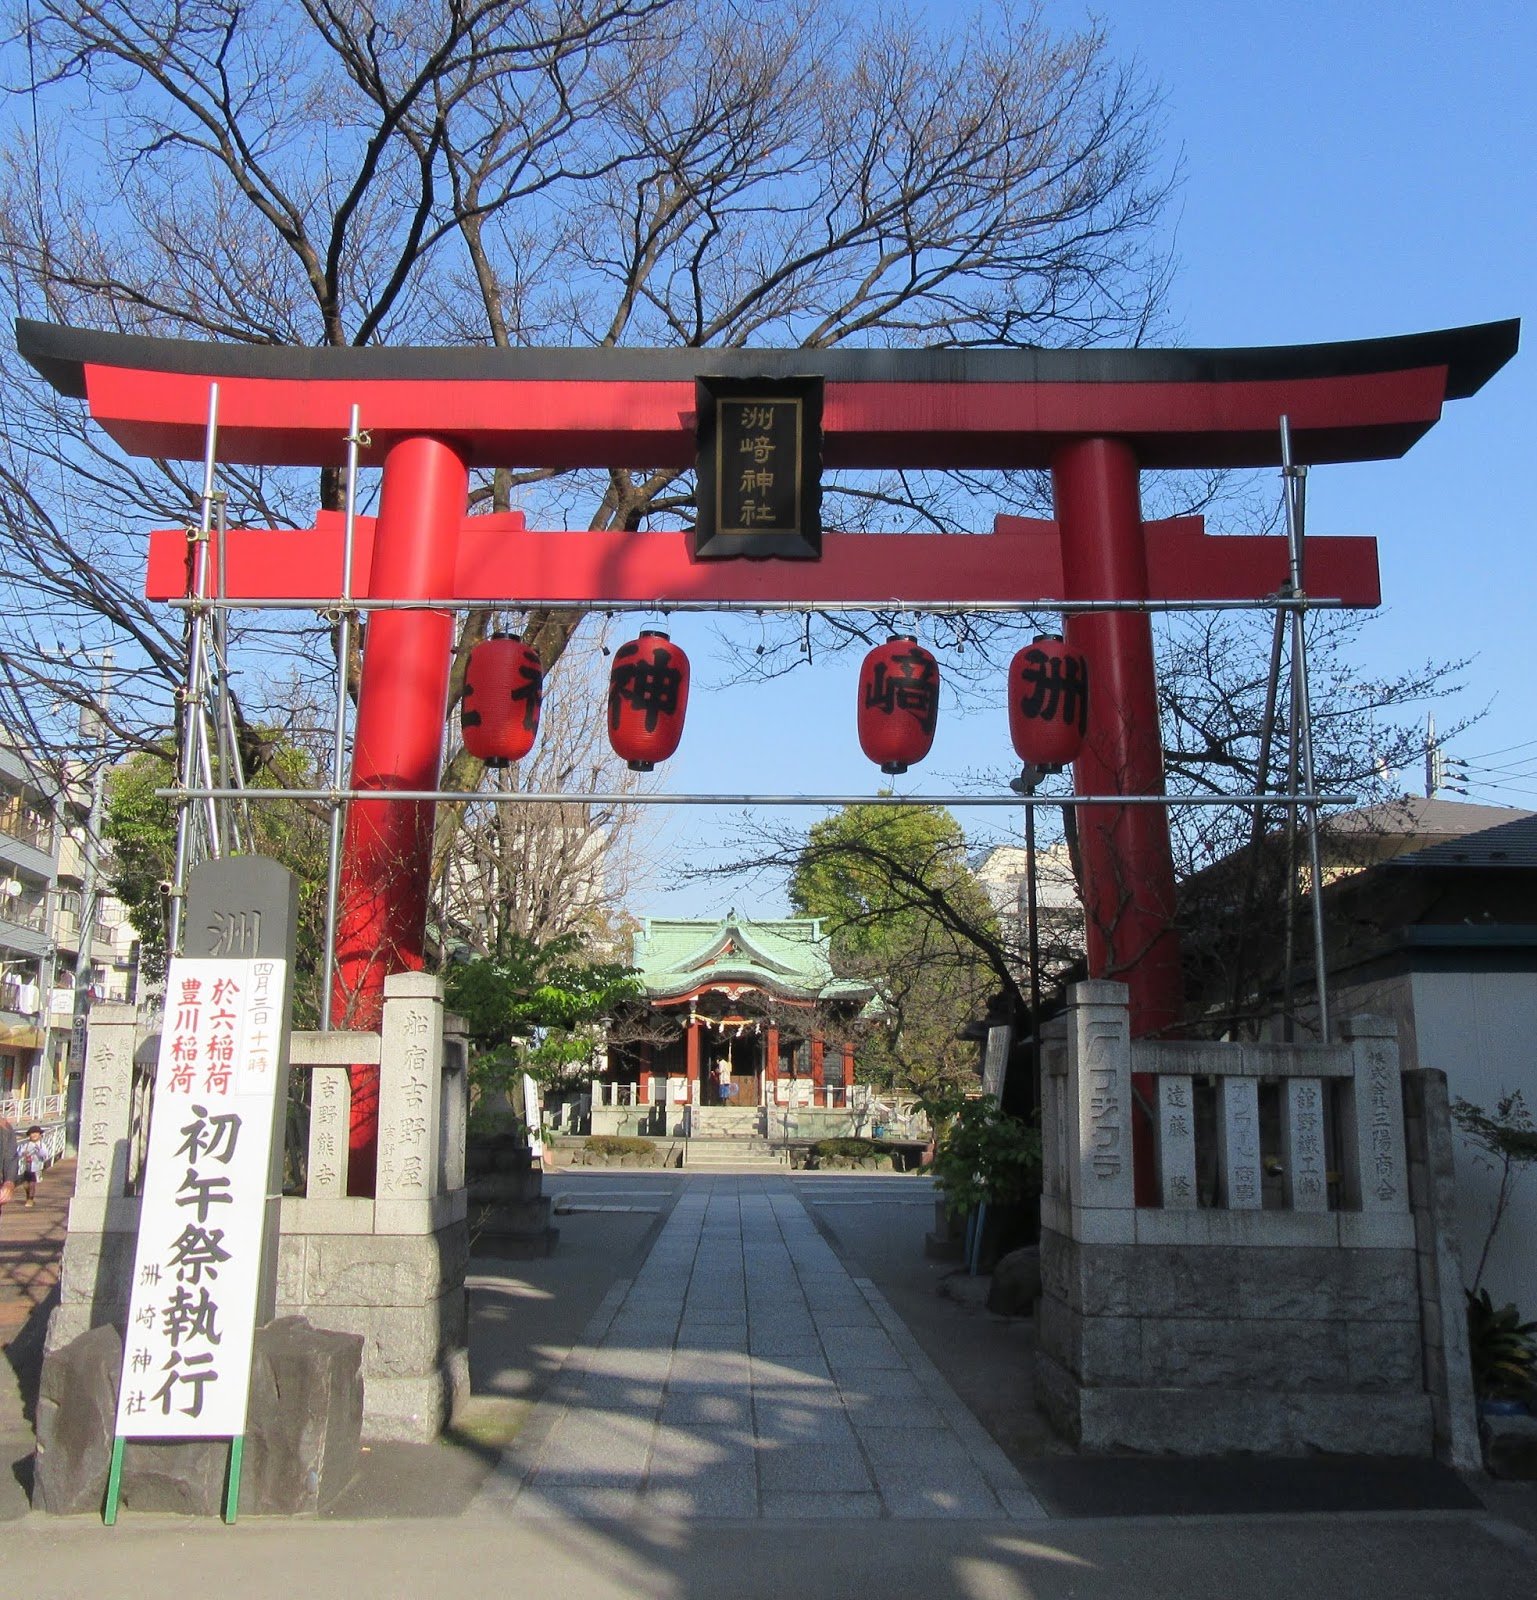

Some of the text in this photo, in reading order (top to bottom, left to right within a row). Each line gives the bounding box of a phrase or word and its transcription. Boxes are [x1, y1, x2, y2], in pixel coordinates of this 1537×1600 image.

[610, 643, 682, 733] 神
[1021, 648, 1088, 738] 洲
[206, 910, 262, 959] 洲
[166, 976, 203, 1094] 豊川稲荷
[203, 977, 240, 1096] 於六稲荷
[247, 962, 274, 1073] 四月三日十一時
[316, 1075, 338, 1186] 吉野熊吉
[397, 1010, 428, 1188] 船宿吉野屋
[150, 1103, 243, 1420] 初午祭執行
[125, 1263, 162, 1416] 洲崎神社
